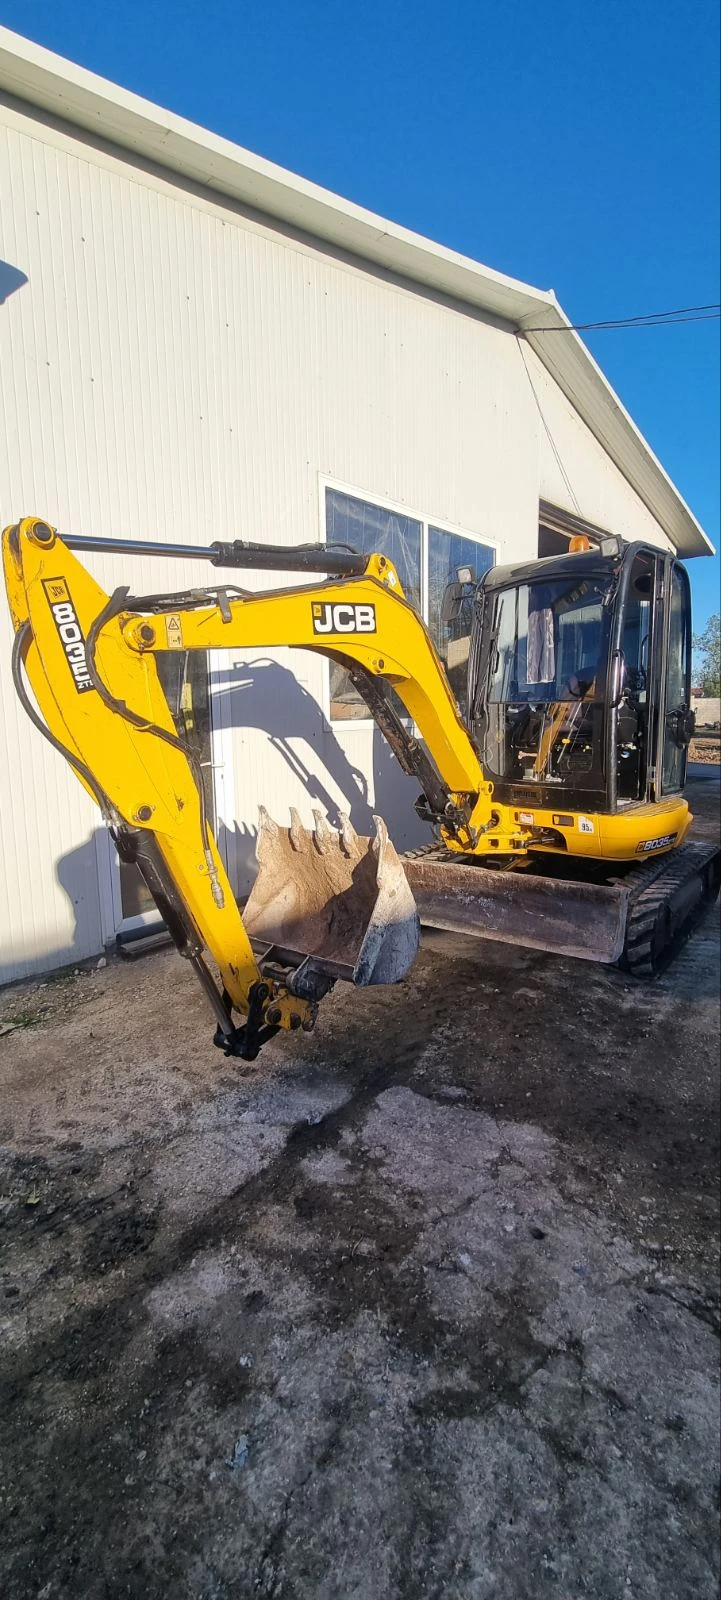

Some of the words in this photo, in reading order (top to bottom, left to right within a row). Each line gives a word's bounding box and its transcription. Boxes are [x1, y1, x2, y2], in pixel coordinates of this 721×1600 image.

[314, 604, 376, 632] JCB
[52, 602, 91, 682] 8035
[643, 835, 671, 851] 8035
